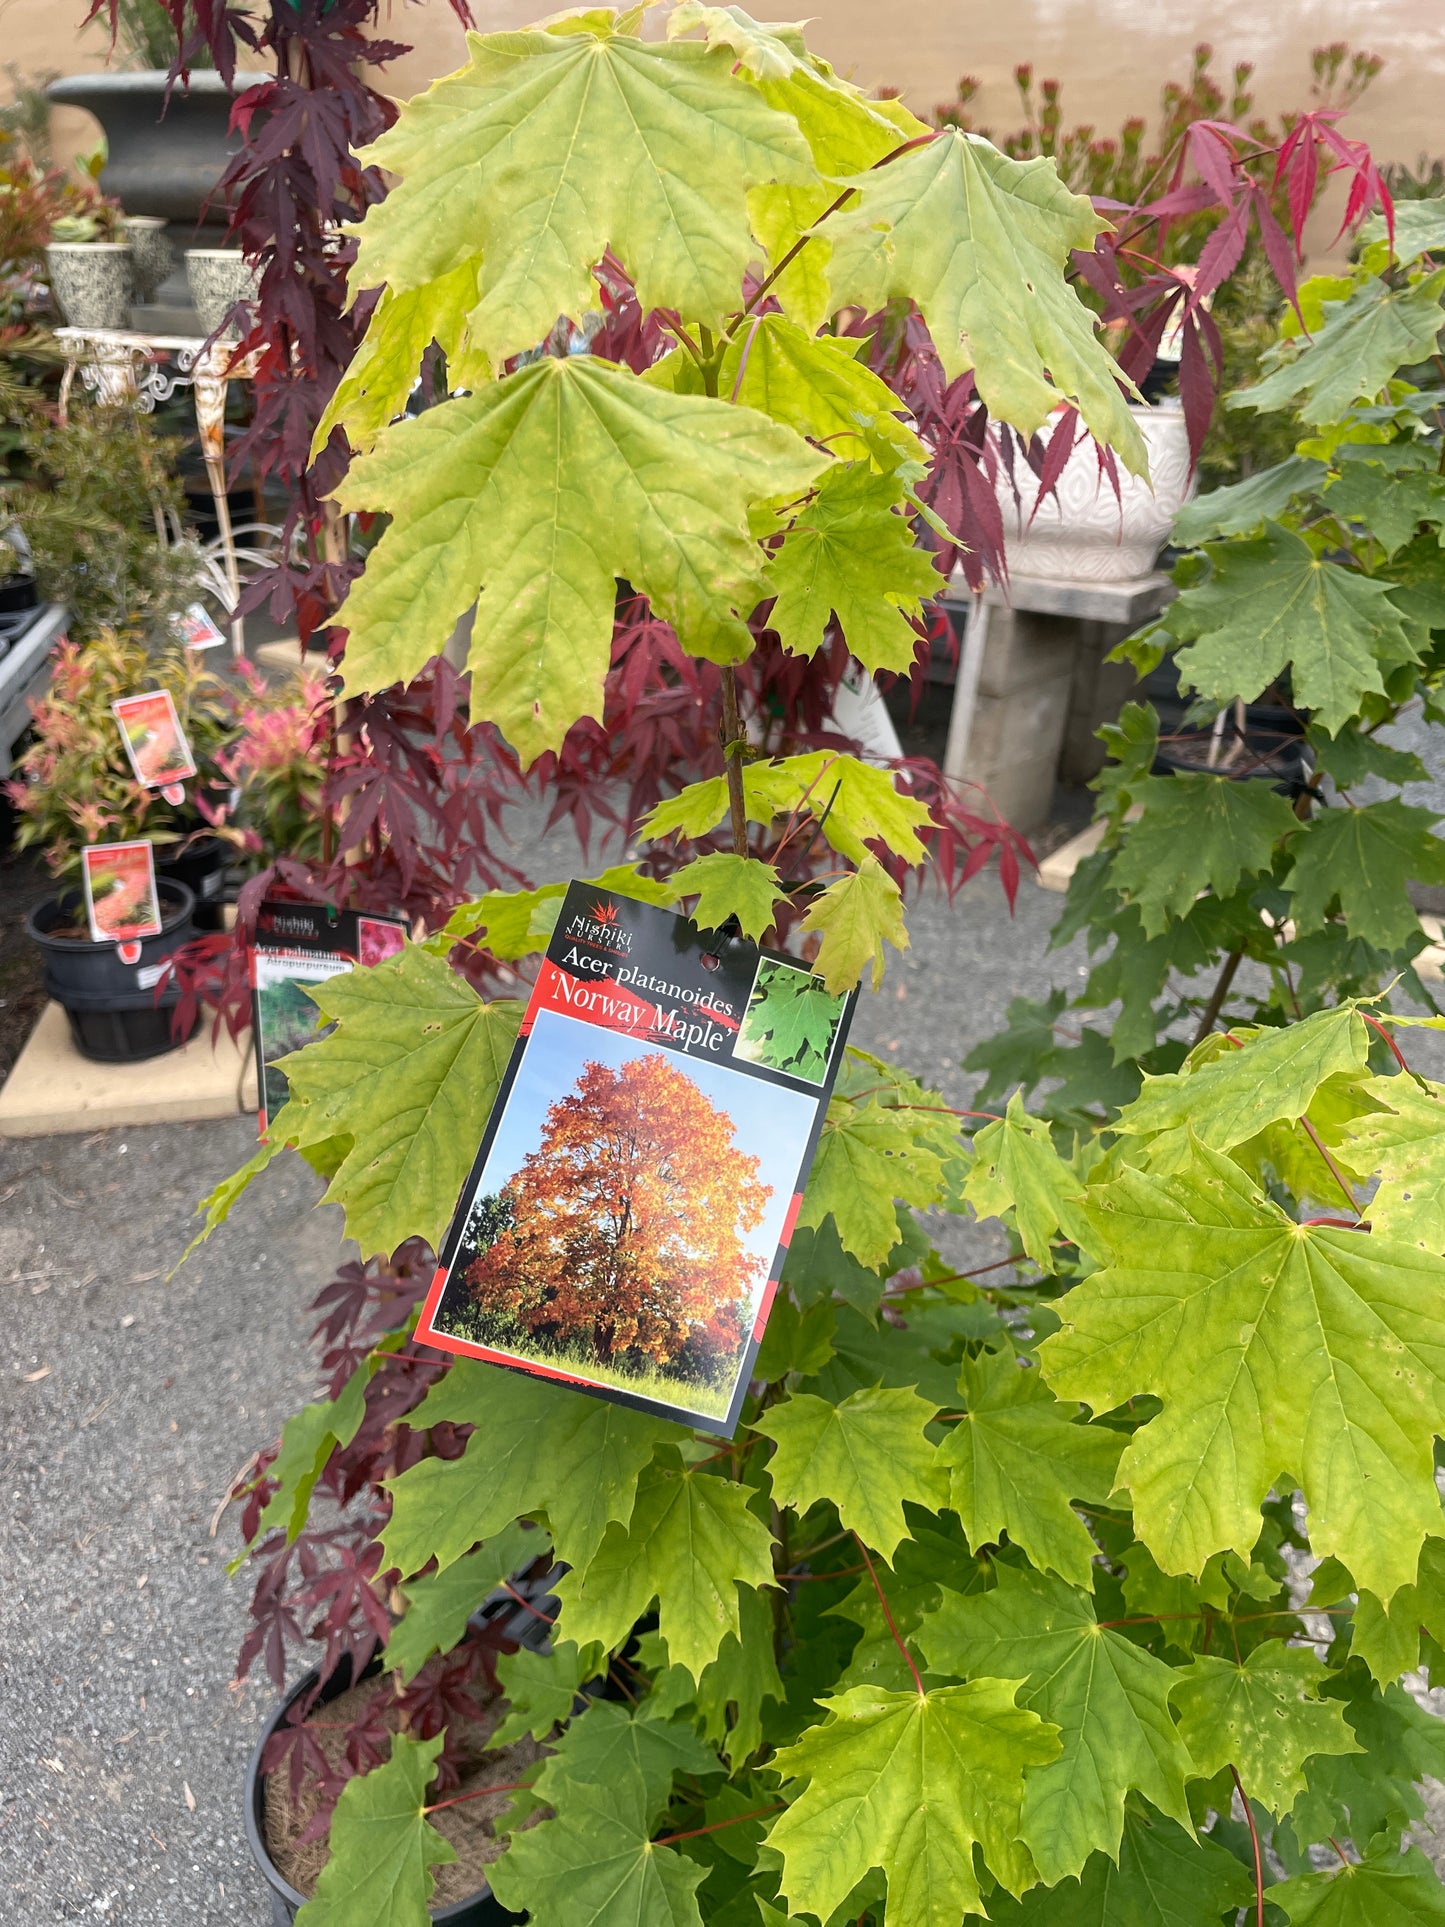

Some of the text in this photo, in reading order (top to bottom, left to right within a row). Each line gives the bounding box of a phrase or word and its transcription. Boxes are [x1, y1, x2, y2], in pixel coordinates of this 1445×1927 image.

[564, 934, 586, 944] QUALITY
[565, 927, 633, 954] NURSERY
[572, 915, 633, 946] Nishiki
[253, 942, 341, 961] Acer palmatum
[562, 946, 733, 1016] Acer platanoides
